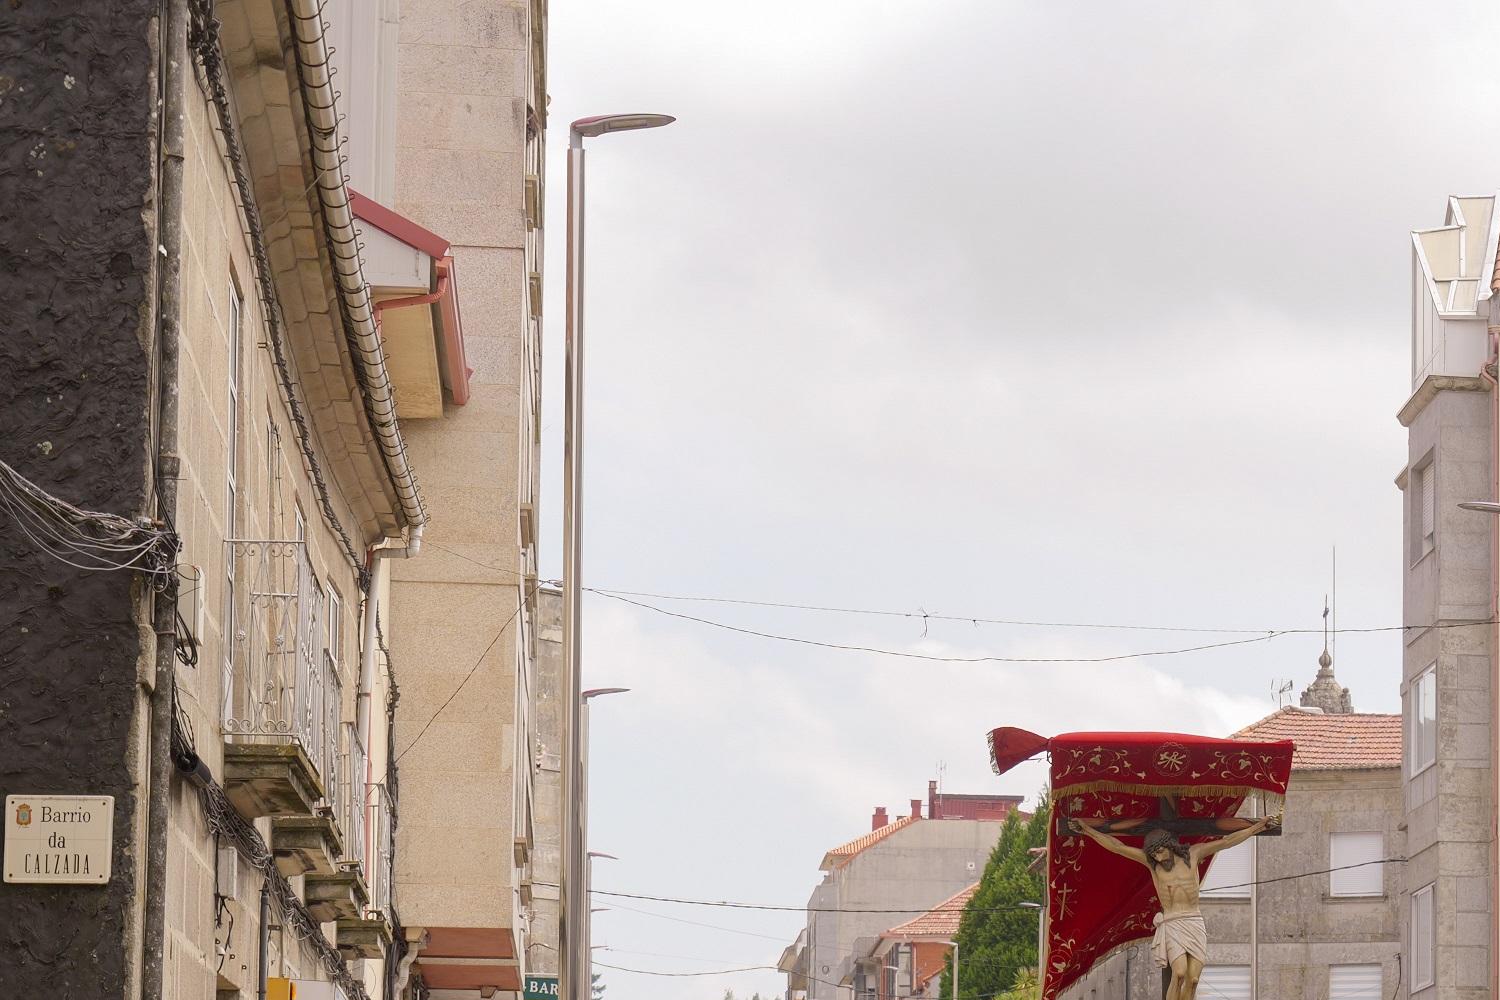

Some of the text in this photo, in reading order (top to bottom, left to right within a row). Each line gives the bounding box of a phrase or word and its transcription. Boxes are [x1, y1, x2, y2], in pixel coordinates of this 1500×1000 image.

[40, 805, 91, 823] Barrio
[48, 832, 66, 848] da
[25, 854, 90, 874] CALZADA
